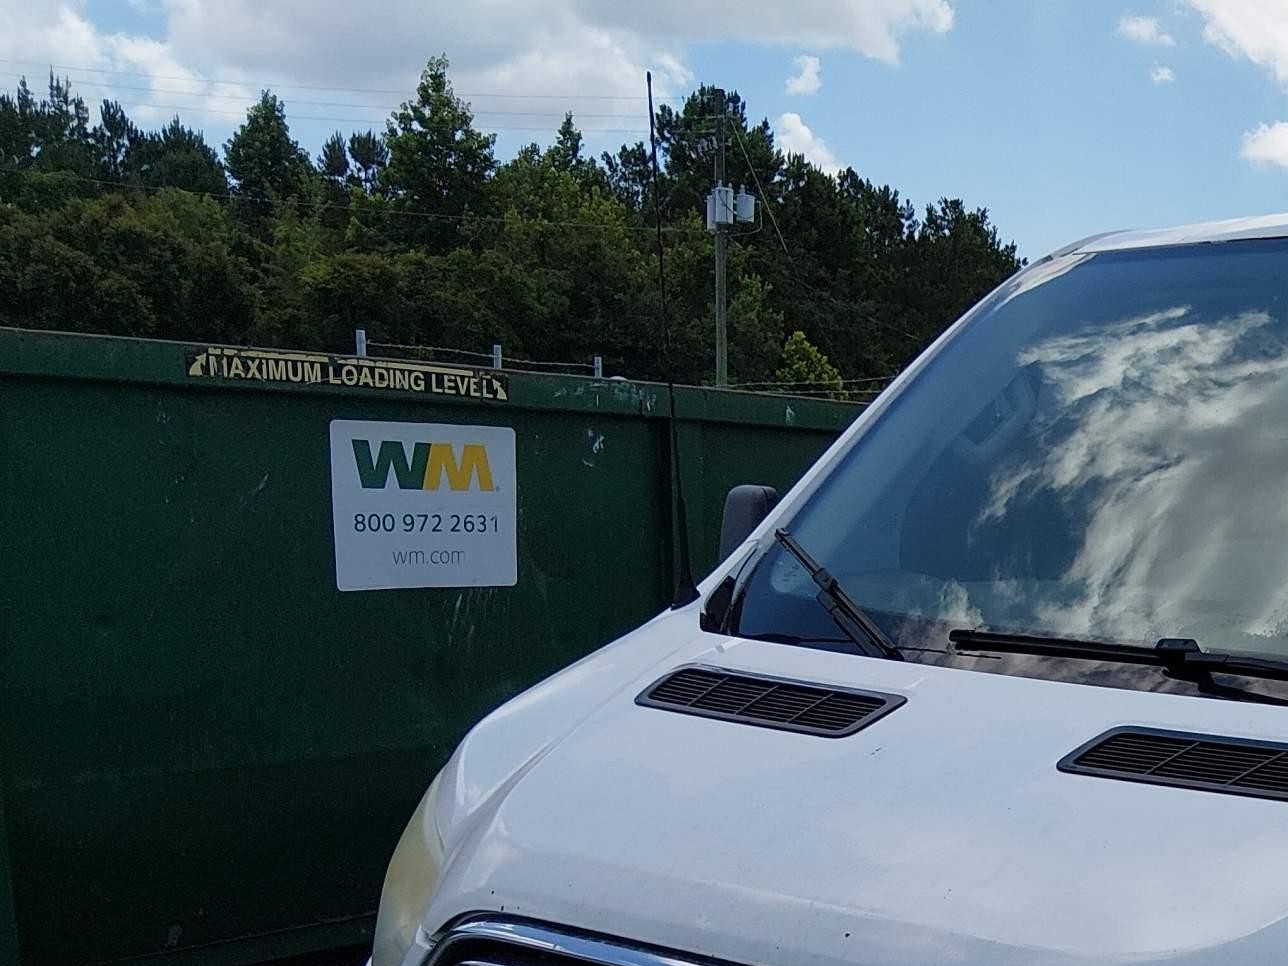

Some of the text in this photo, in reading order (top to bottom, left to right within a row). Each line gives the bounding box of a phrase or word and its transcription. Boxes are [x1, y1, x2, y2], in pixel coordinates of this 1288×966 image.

[208, 354, 493, 399] MAXIMUM LOADING LEVEL
[351, 439, 494, 492] WM
[354, 513, 499, 533] 800 972 2631
[392, 549, 465, 565] wm.com
